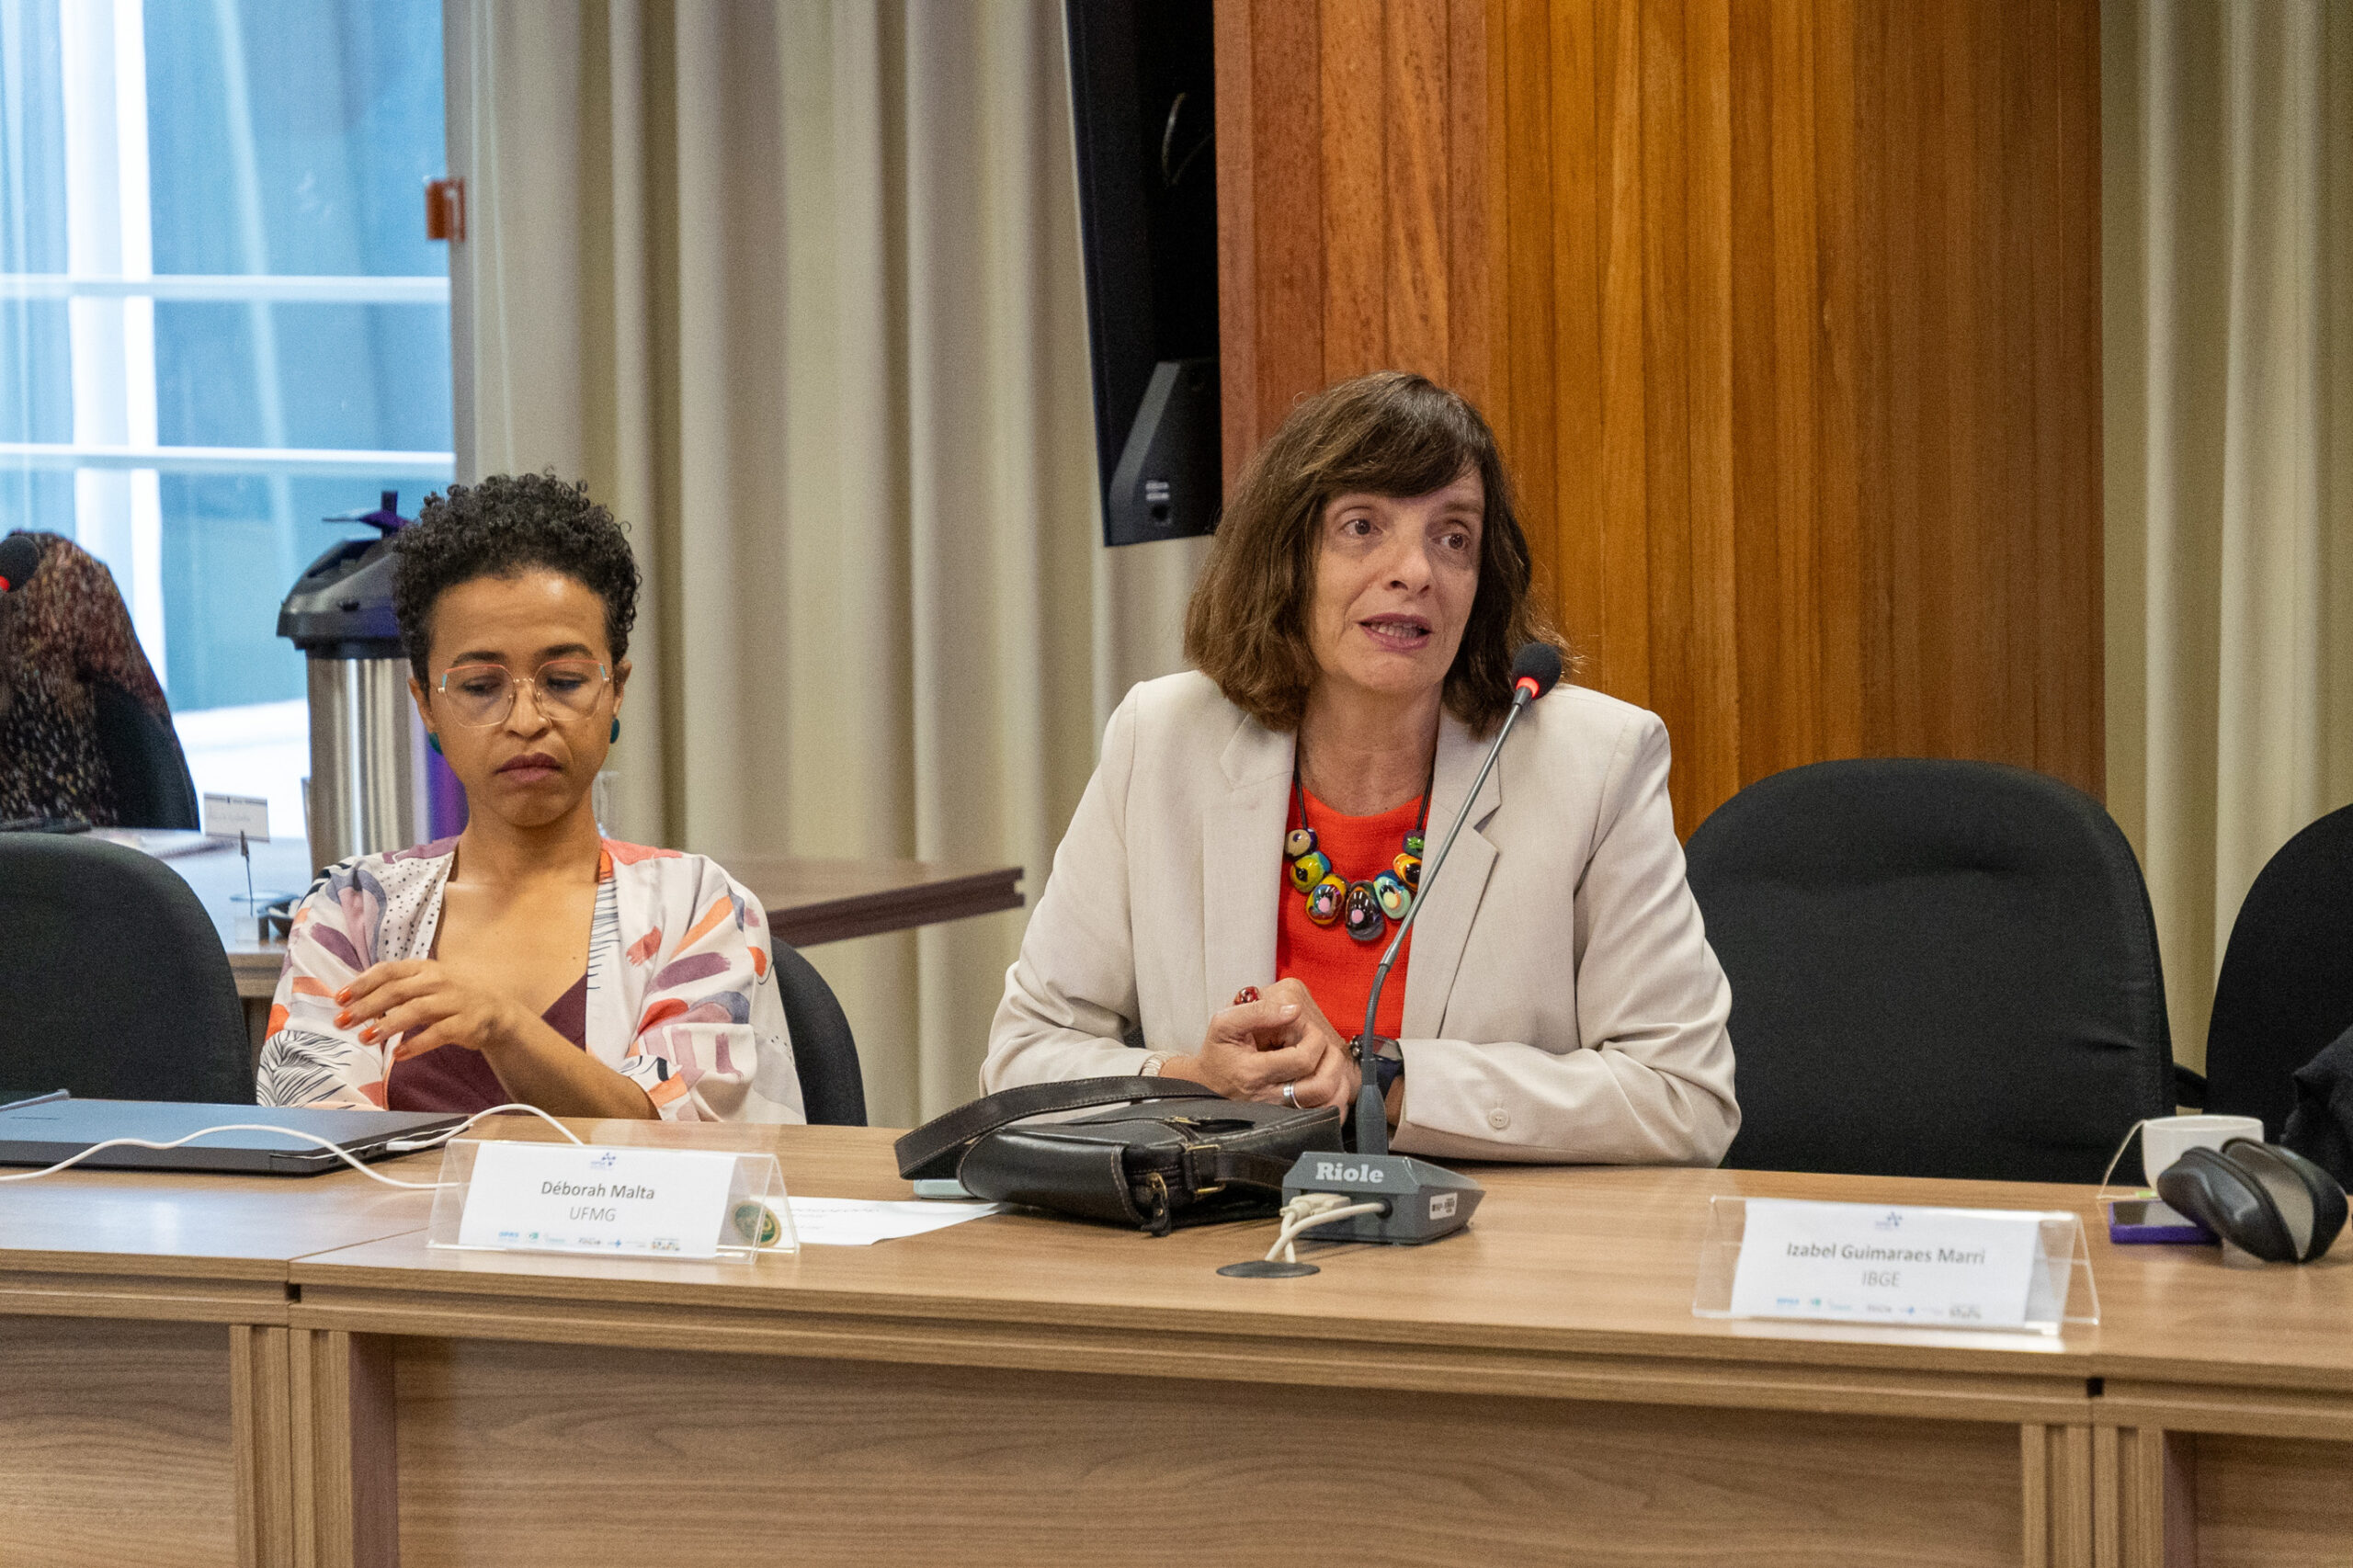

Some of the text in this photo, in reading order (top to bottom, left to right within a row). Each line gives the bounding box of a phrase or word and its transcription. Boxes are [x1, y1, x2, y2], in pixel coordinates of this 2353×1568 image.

[1315, 1162, 1384, 1184] Riole
[540, 1180, 655, 1199] Déborah Malta
[569, 1206, 618, 1222] UFMG
[1787, 1243, 1986, 1265] Izabel Guimaraes Marri
[1861, 1271, 1902, 1288] IBGE
